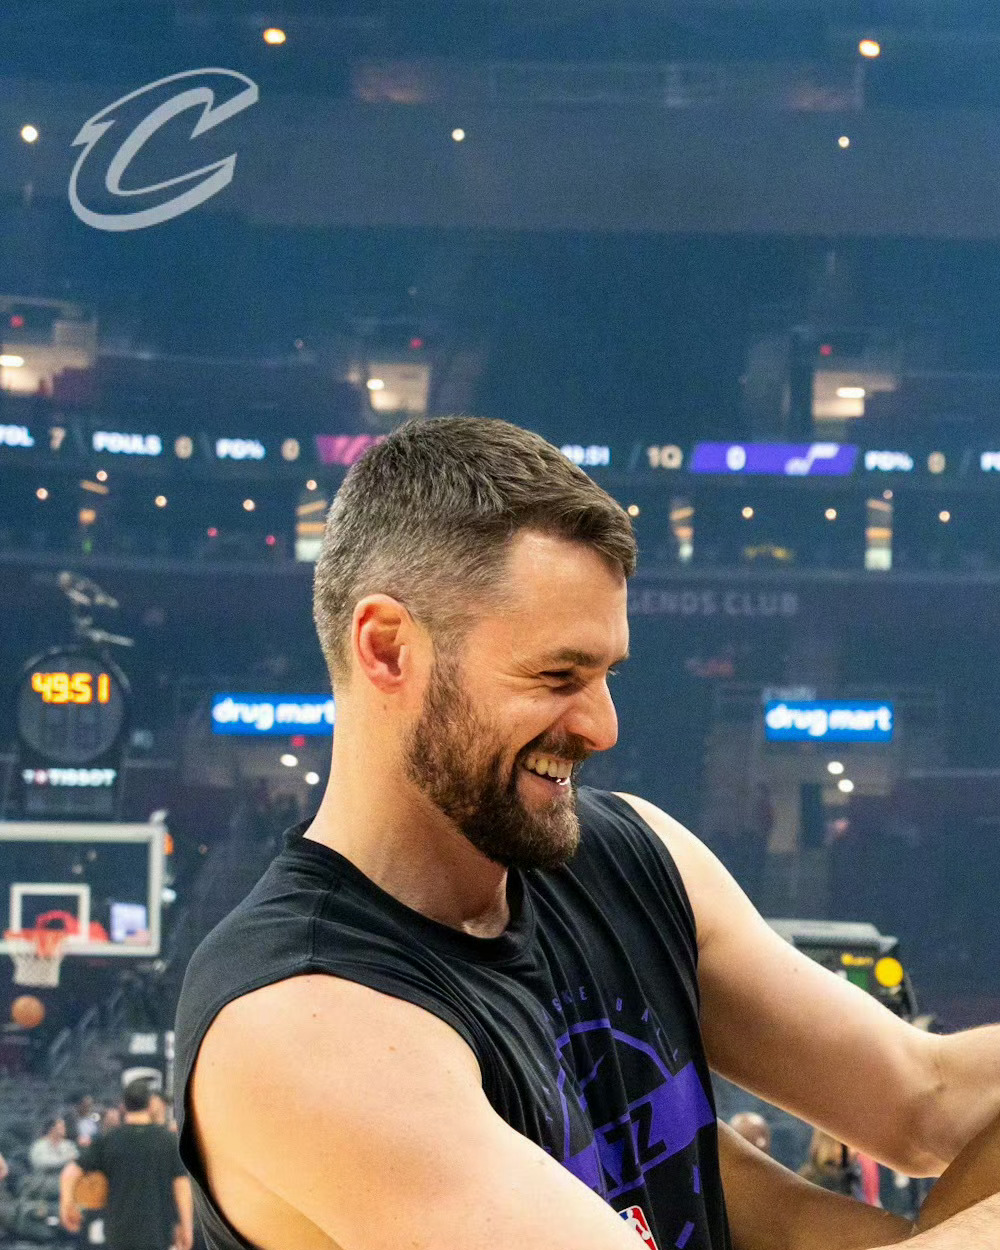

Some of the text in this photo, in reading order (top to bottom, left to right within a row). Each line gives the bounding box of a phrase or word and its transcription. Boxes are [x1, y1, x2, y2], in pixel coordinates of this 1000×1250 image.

[93, 431, 162, 456] FOULS
[175, 436, 193, 459] 0
[282, 438, 300, 461] 0
[726, 445, 747, 471] 0
[927, 451, 946, 474] 0
[212, 697, 335, 731] drug mart
[764, 703, 892, 737] drug mart
[49, 768, 116, 787] TISSOT
